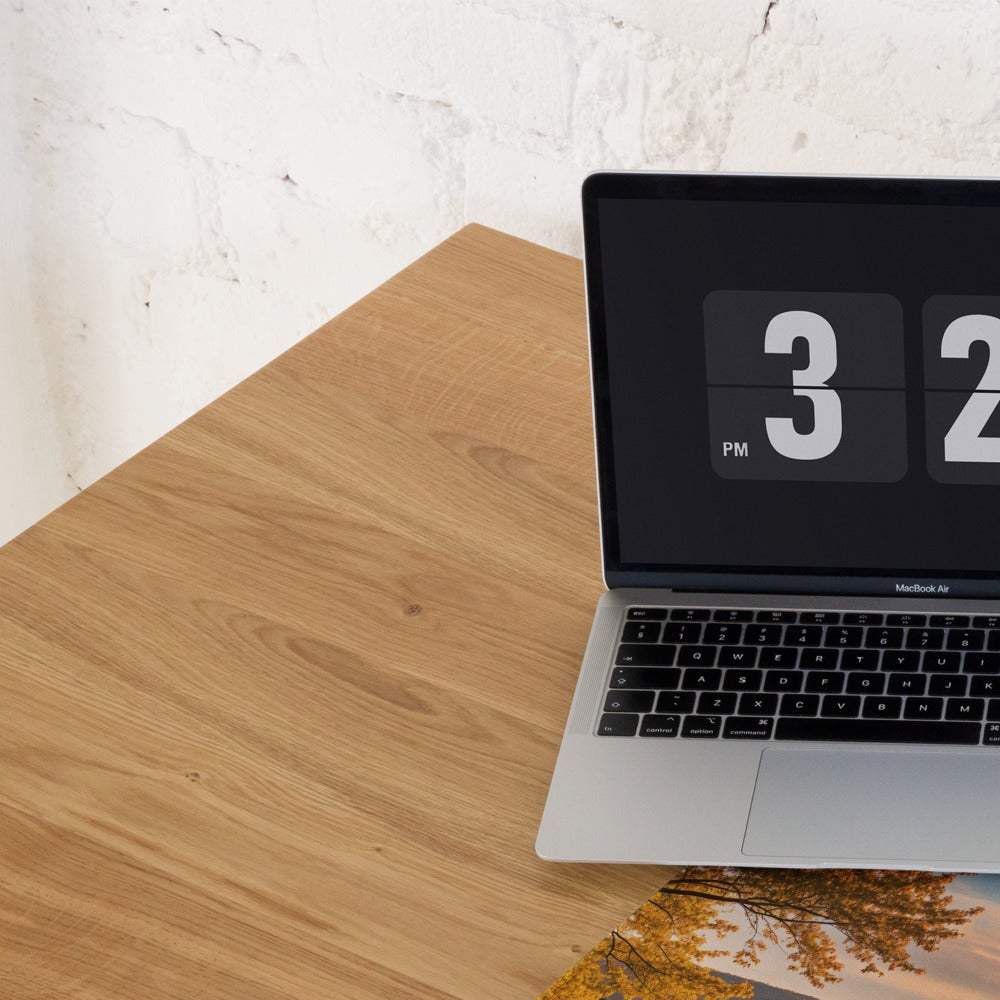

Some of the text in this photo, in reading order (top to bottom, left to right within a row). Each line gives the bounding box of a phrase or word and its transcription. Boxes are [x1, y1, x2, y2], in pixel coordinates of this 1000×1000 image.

[765, 311, 842, 460] 3
[723, 442, 748, 456] PM
[895, 584, 950, 592] MacBook Air
